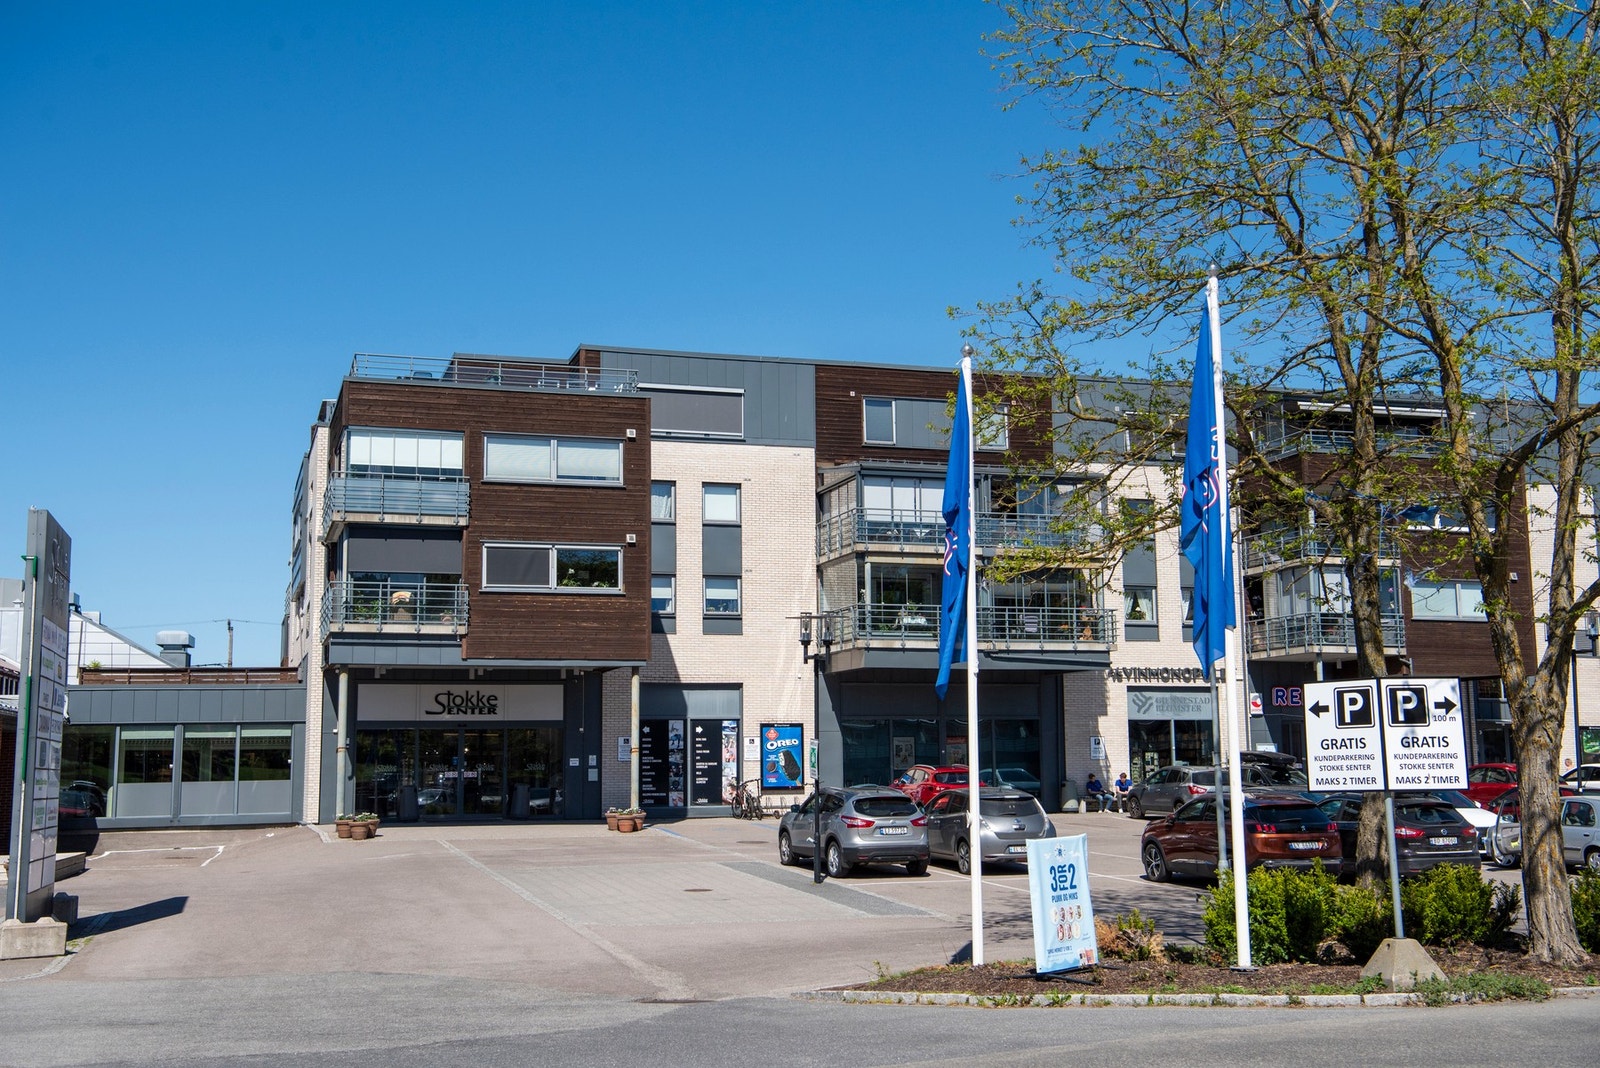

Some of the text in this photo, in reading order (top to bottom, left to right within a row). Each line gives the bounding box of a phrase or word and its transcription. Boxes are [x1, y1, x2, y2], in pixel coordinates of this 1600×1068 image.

[425, 690, 498, 715] Stokke
[1343, 692, 1364, 723] P
[1396, 690, 1418, 722] P
[766, 739, 799, 750] OREO
[1320, 738, 1367, 750] GRATIS
[1400, 736, 1450, 748] GRATIS
[1314, 753, 1376, 762] KUNDEPARKERING
[1393, 752, 1459, 760] KUNDEPARKERING
[1319, 763, 1372, 772] STOKKE SENTER
[1427, 762, 1455, 770] SENTER
[1315, 776, 1377, 786] MAKS 2 TIMER
[1395, 775, 1461, 785] MAKS 2 TIMER
[1050, 863, 1077, 893] 3 FOR 2
